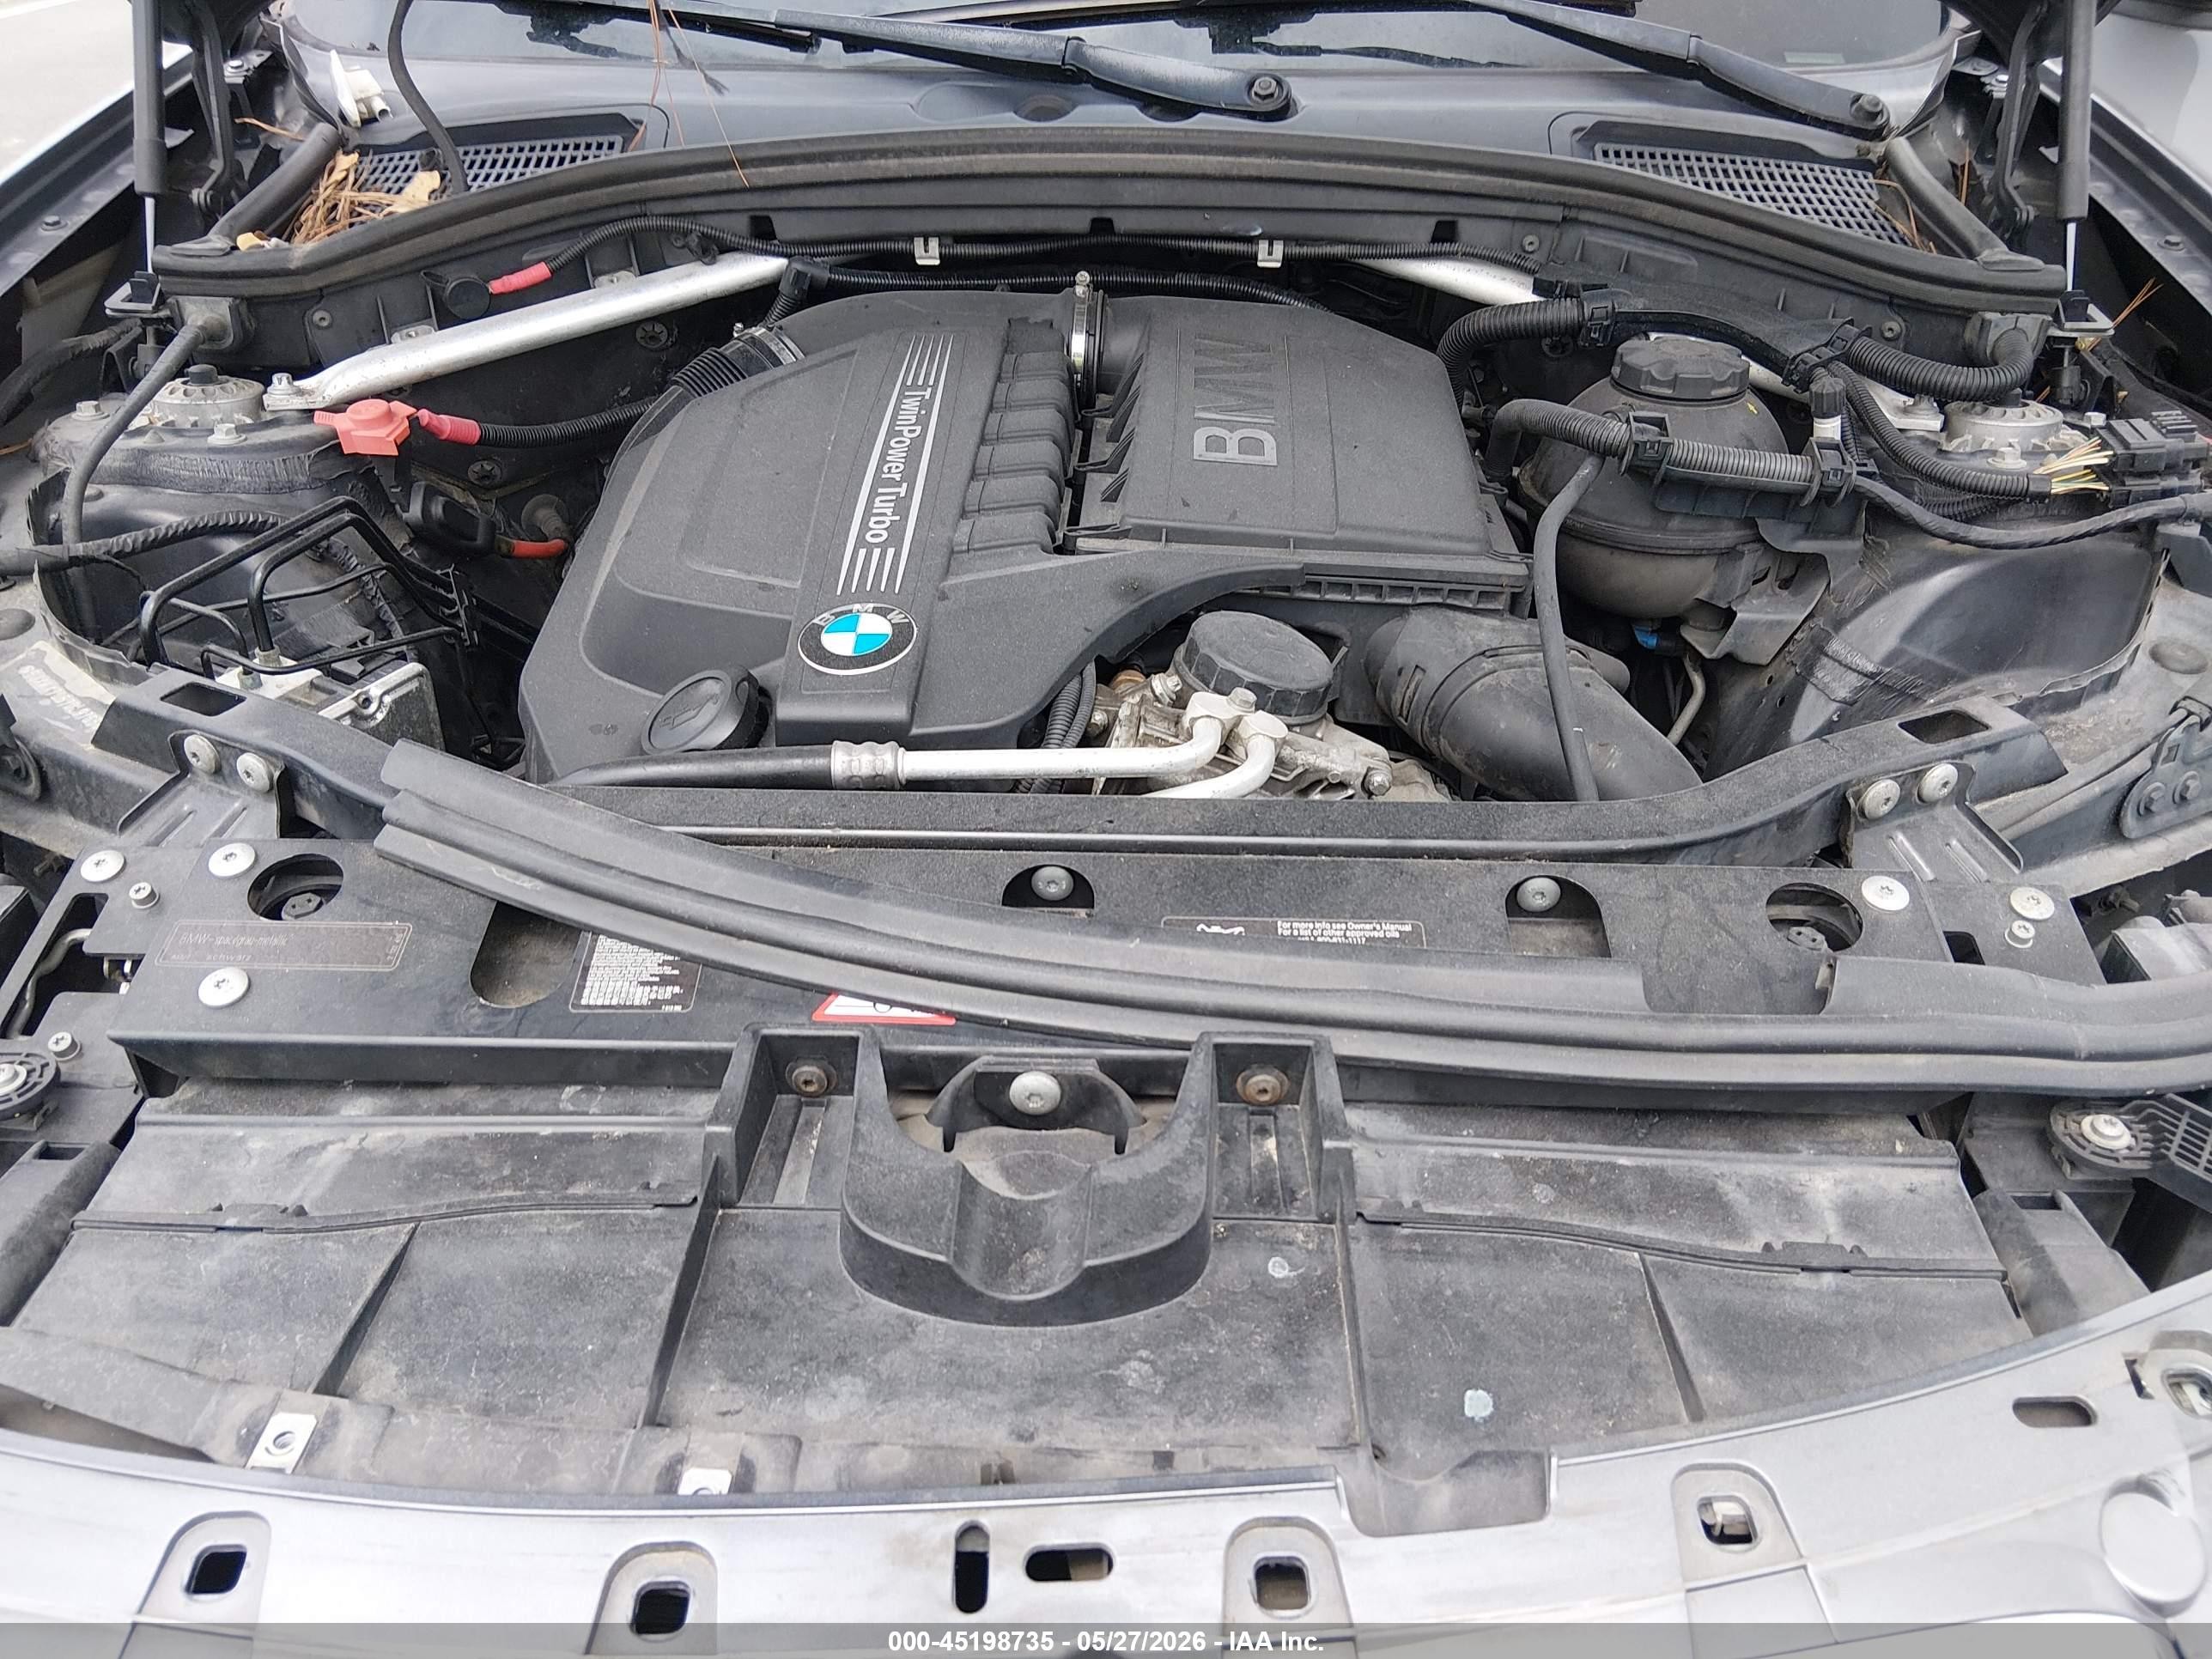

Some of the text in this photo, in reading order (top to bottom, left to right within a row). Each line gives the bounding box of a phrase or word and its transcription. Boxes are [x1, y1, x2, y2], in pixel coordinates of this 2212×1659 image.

[1193, 331, 1279, 466] BMW
[865, 387, 932, 544] TwinPower Turbo
[811, 603, 910, 626] BMW
[1277, 921, 1291, 929] For
[1347, 922, 1381, 931] Owner's
[1382, 922, 1413, 932] Manual
[1346, 930, 1384, 939] approved
